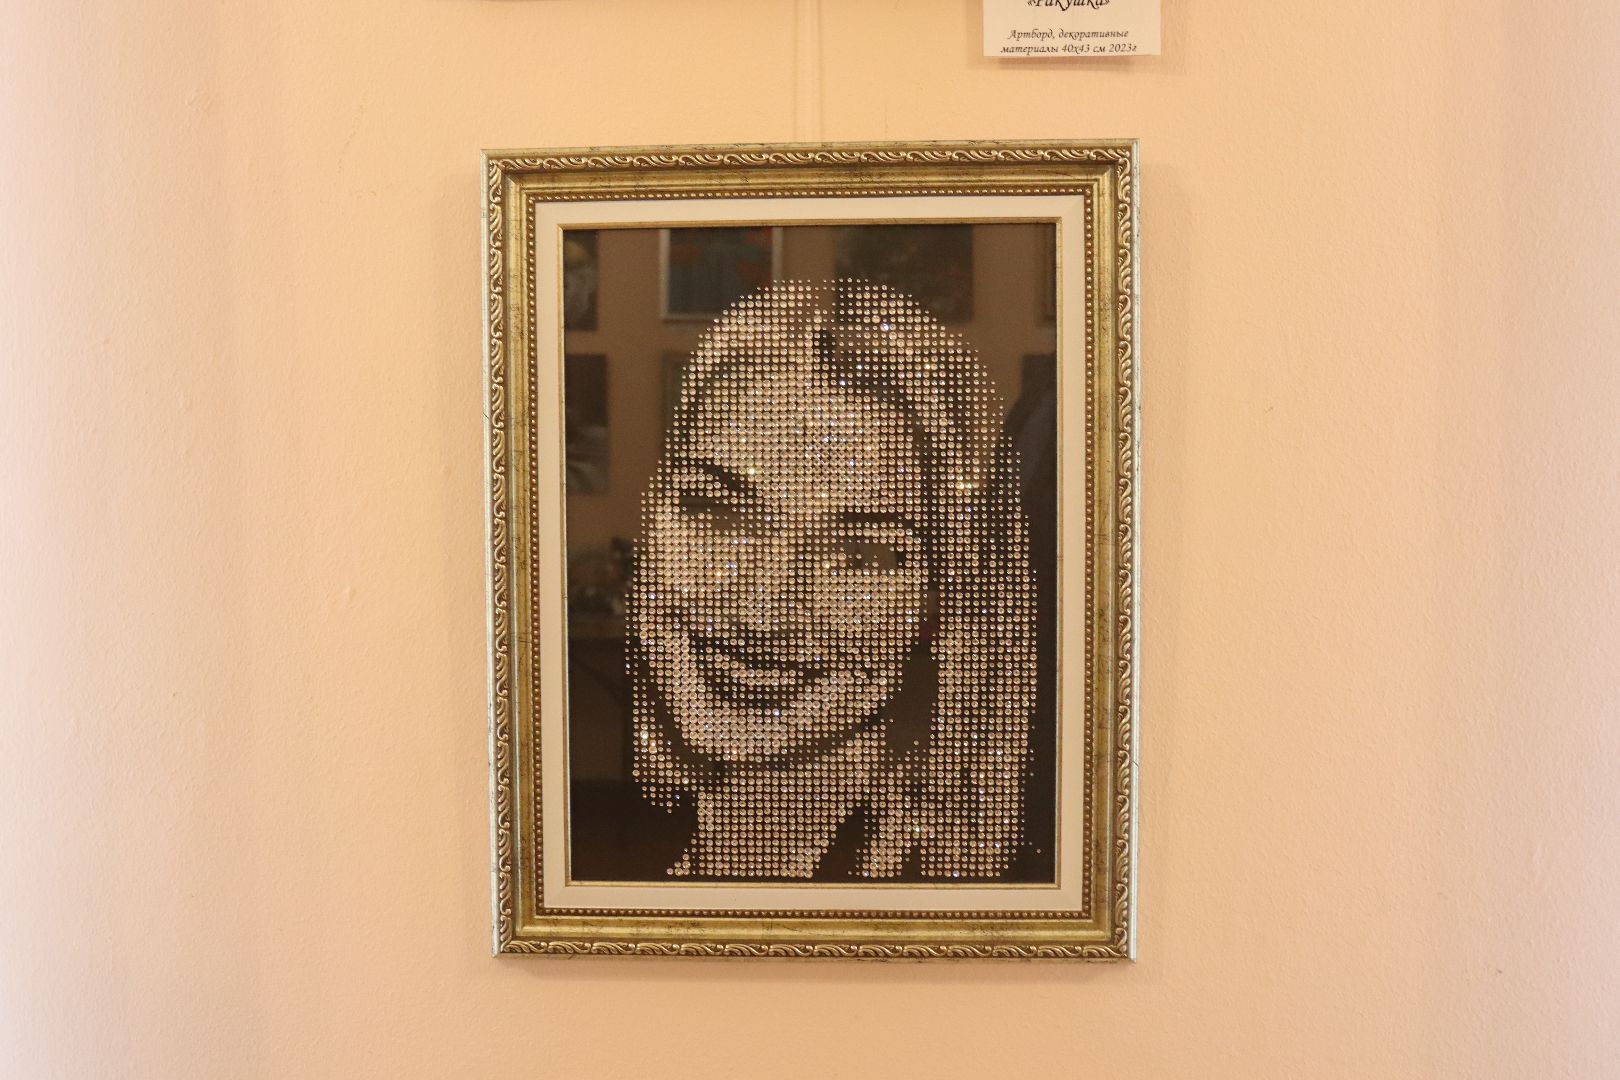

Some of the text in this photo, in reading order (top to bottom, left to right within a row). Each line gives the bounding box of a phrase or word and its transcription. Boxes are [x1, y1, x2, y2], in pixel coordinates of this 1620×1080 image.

[1008, 29, 1129, 41] Артборд, декоративные
[1000, 46, 1058, 55] материалы
[1109, 43, 1137, 53] 2023г
